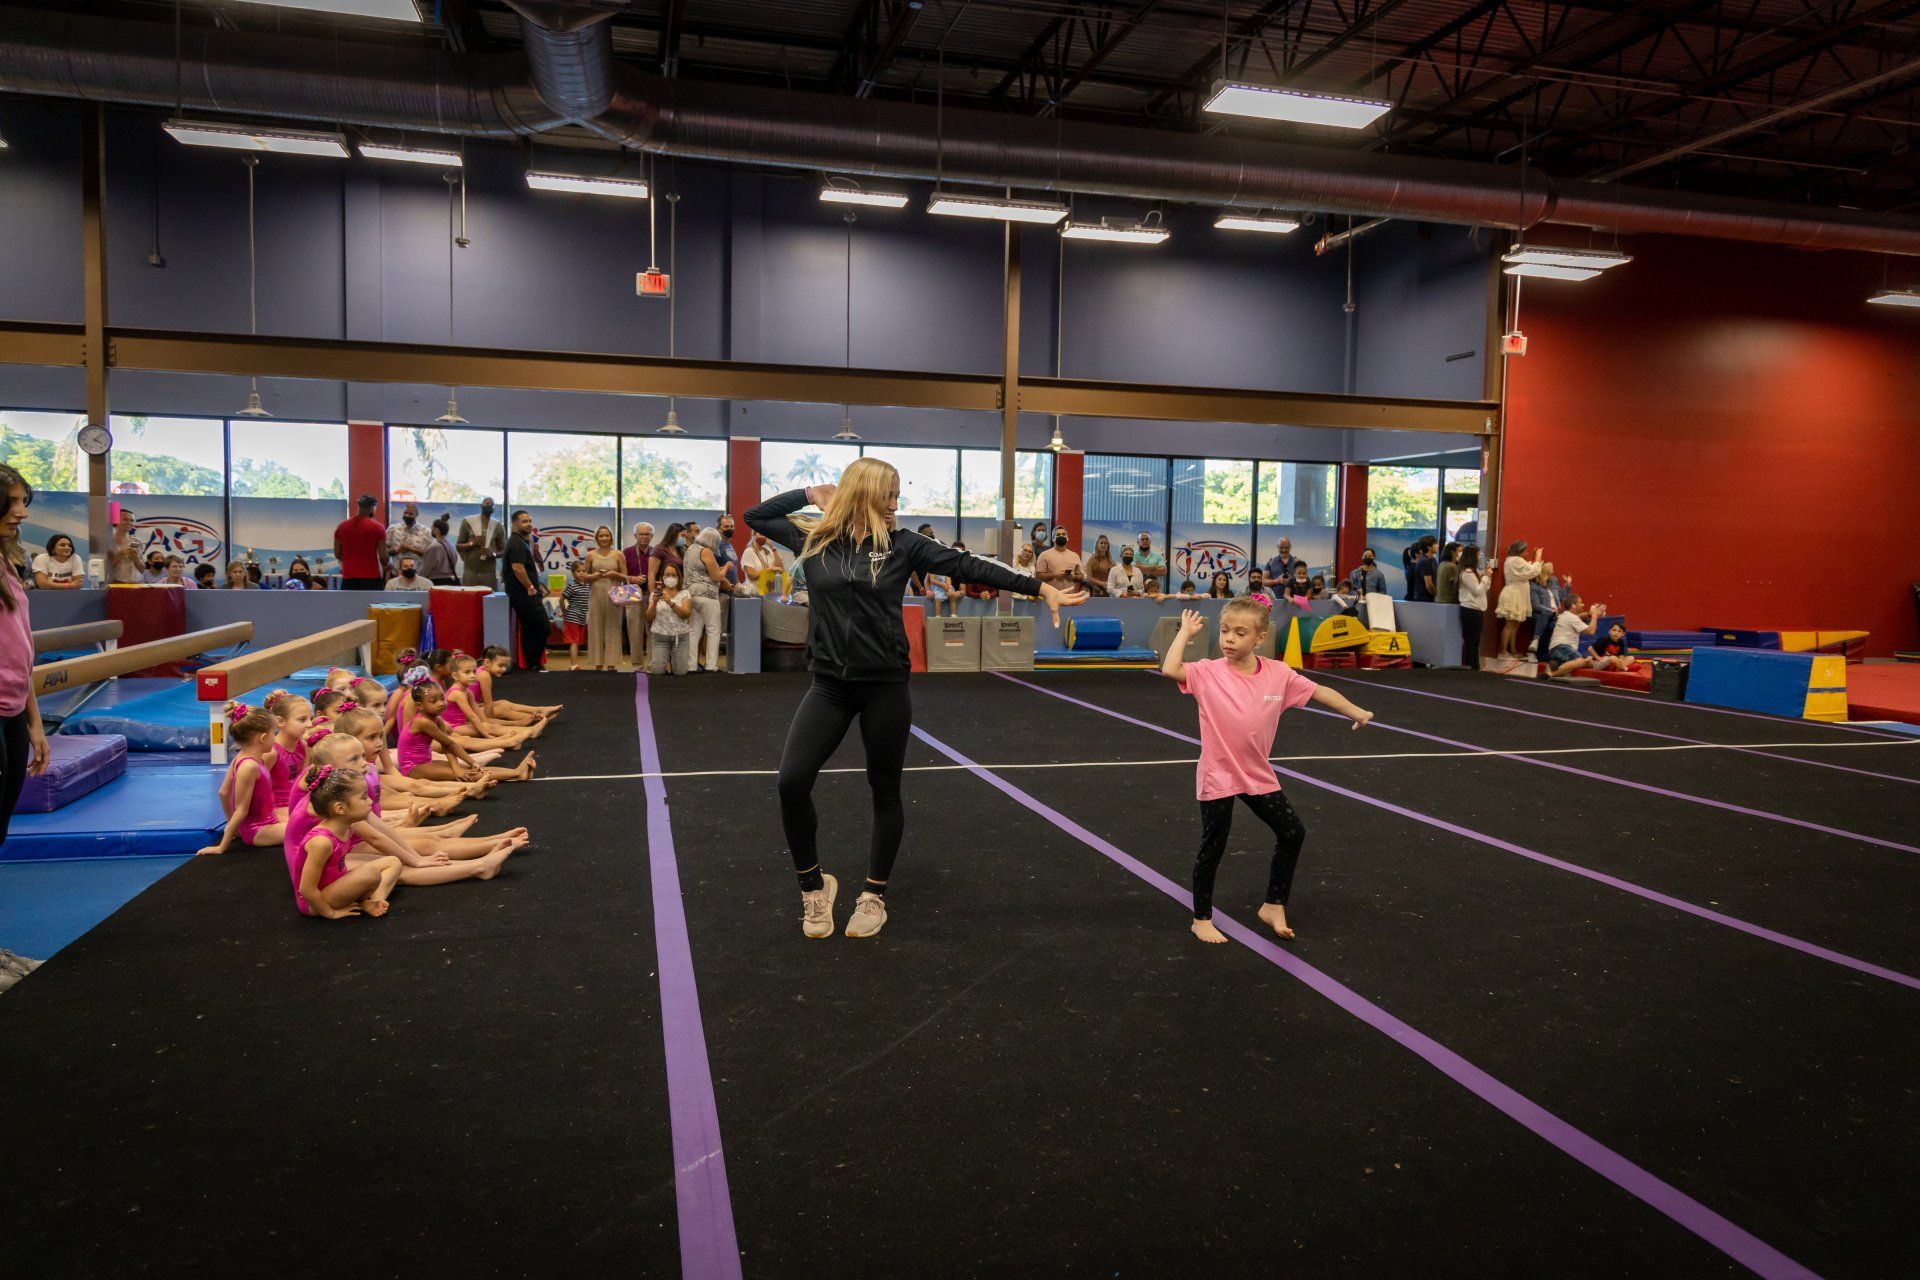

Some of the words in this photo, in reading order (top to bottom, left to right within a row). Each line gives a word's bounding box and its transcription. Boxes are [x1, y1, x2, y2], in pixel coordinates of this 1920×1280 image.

[129, 526, 204, 556] AG
[1173, 542, 1237, 578] TAG
[1389, 637, 1400, 651] A
